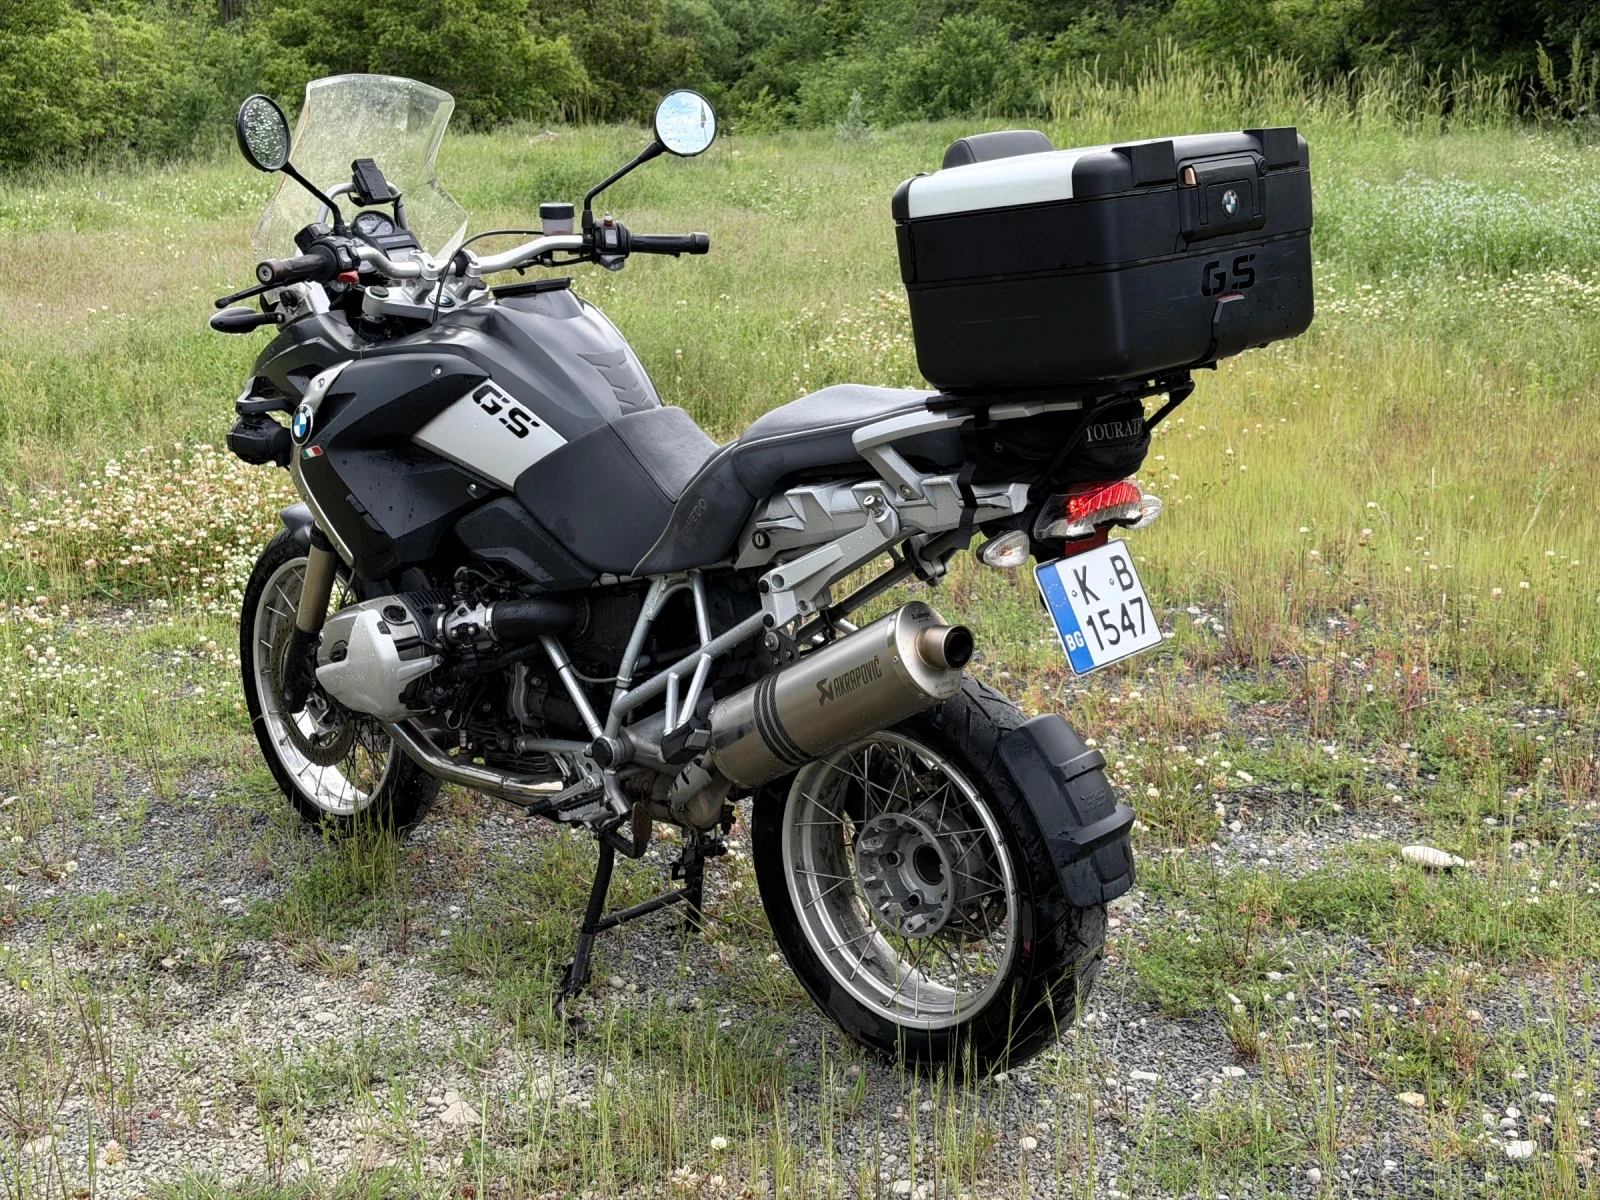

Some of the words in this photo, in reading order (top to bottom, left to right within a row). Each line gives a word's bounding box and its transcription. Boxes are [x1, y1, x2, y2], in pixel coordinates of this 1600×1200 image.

[1202, 253, 1256, 297] GS
[472, 384, 541, 439] GS
[1072, 565, 1101, 605] K
[1109, 554, 1134, 592] B
[1065, 631, 1085, 652] BG
[1086, 596, 1146, 652] 1547
